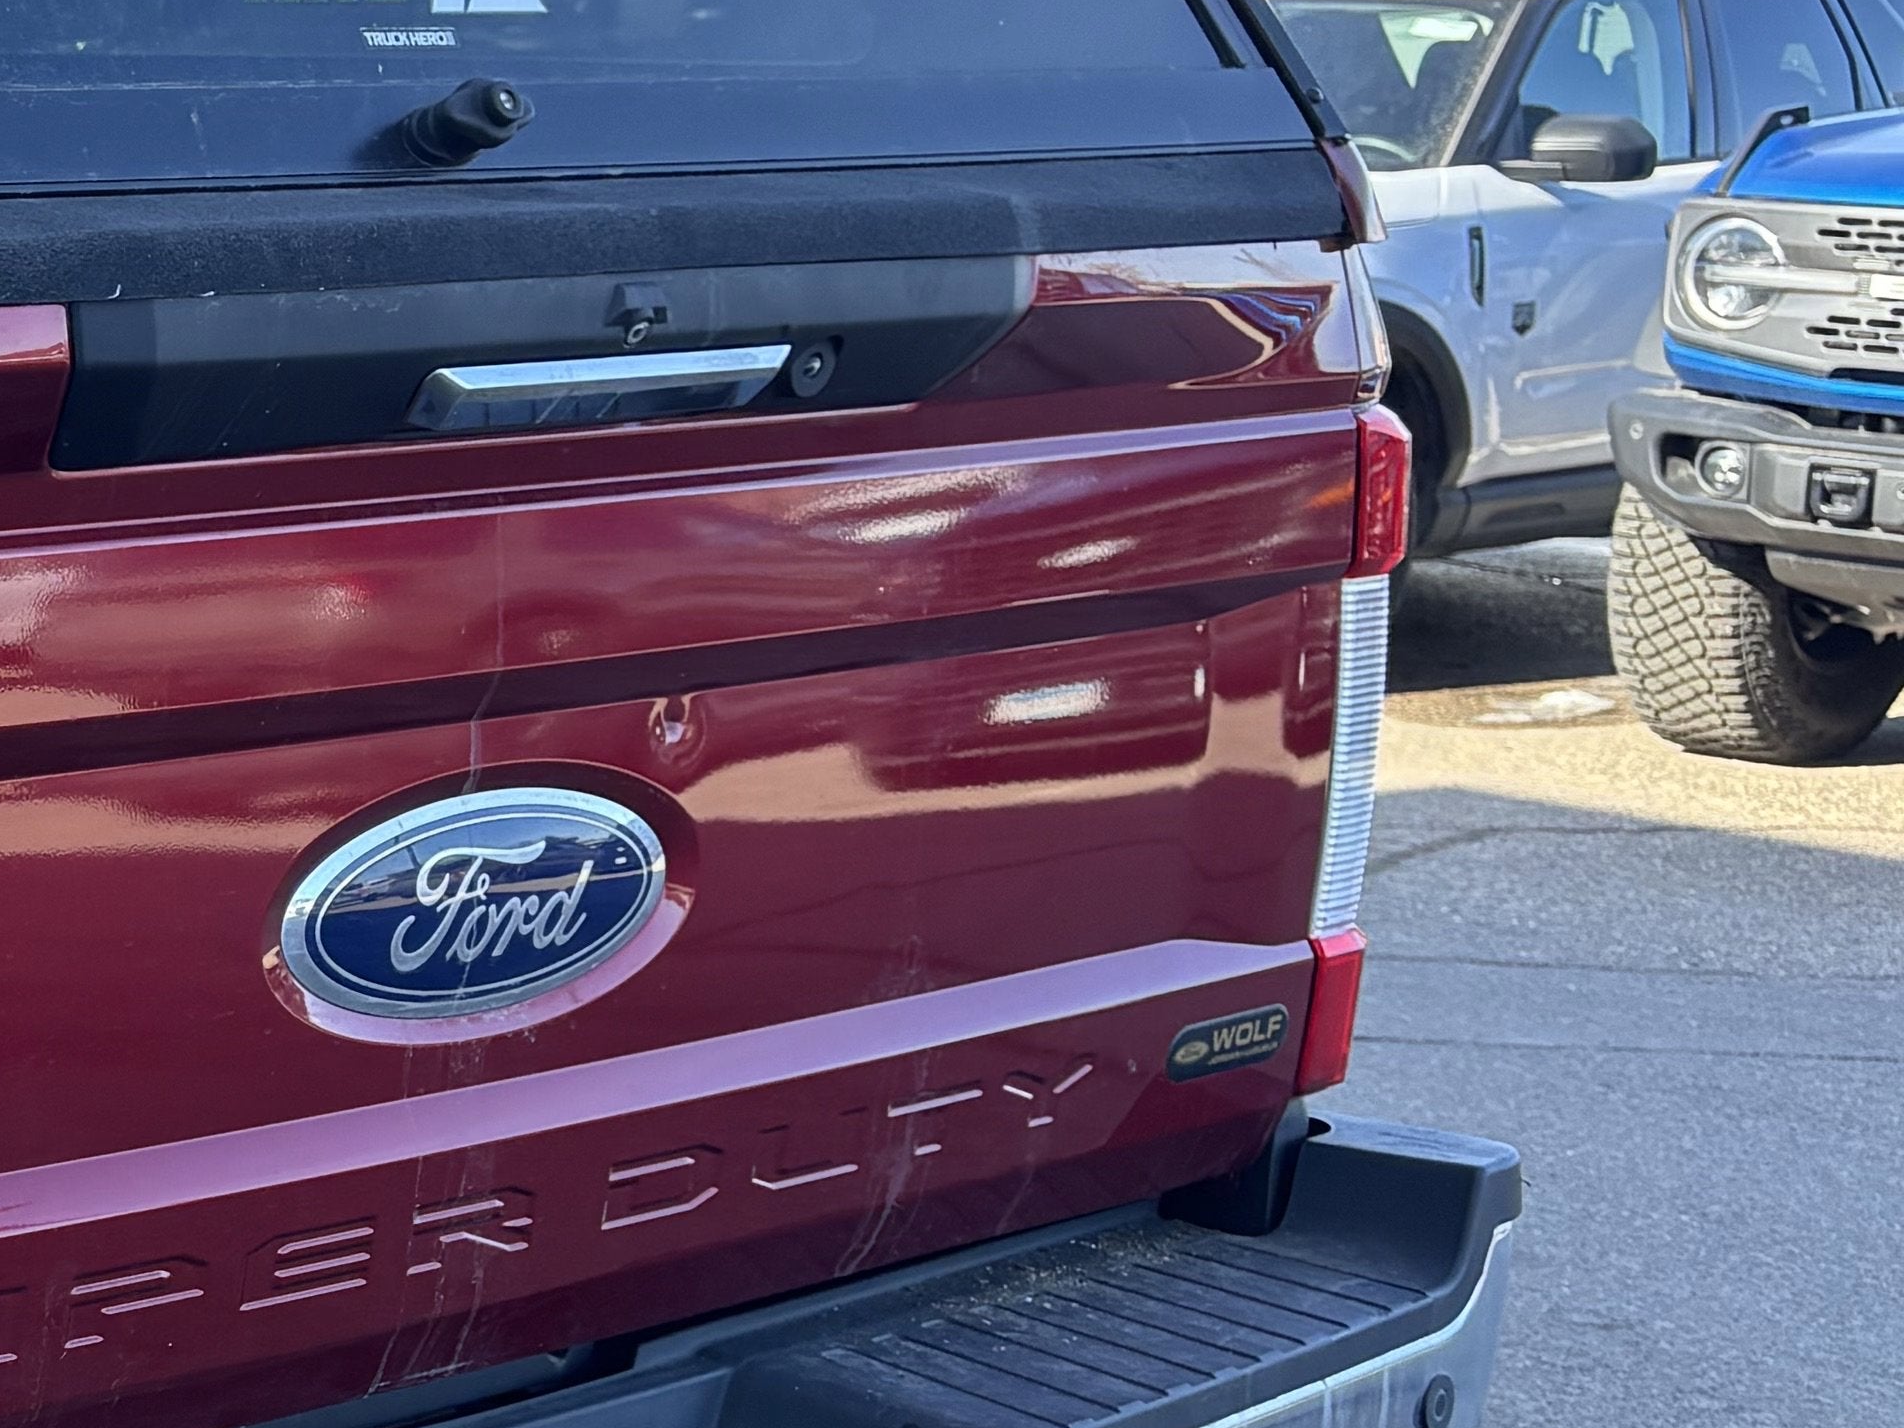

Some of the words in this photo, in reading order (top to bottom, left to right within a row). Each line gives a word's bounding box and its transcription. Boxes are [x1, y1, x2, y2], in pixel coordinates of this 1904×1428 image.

[363, 31, 410, 47] TRUCK
[390, 840, 594, 972] Ford
[1213, 1014, 1283, 1051] WOLF
[601, 1052, 1097, 1231] DUTY
